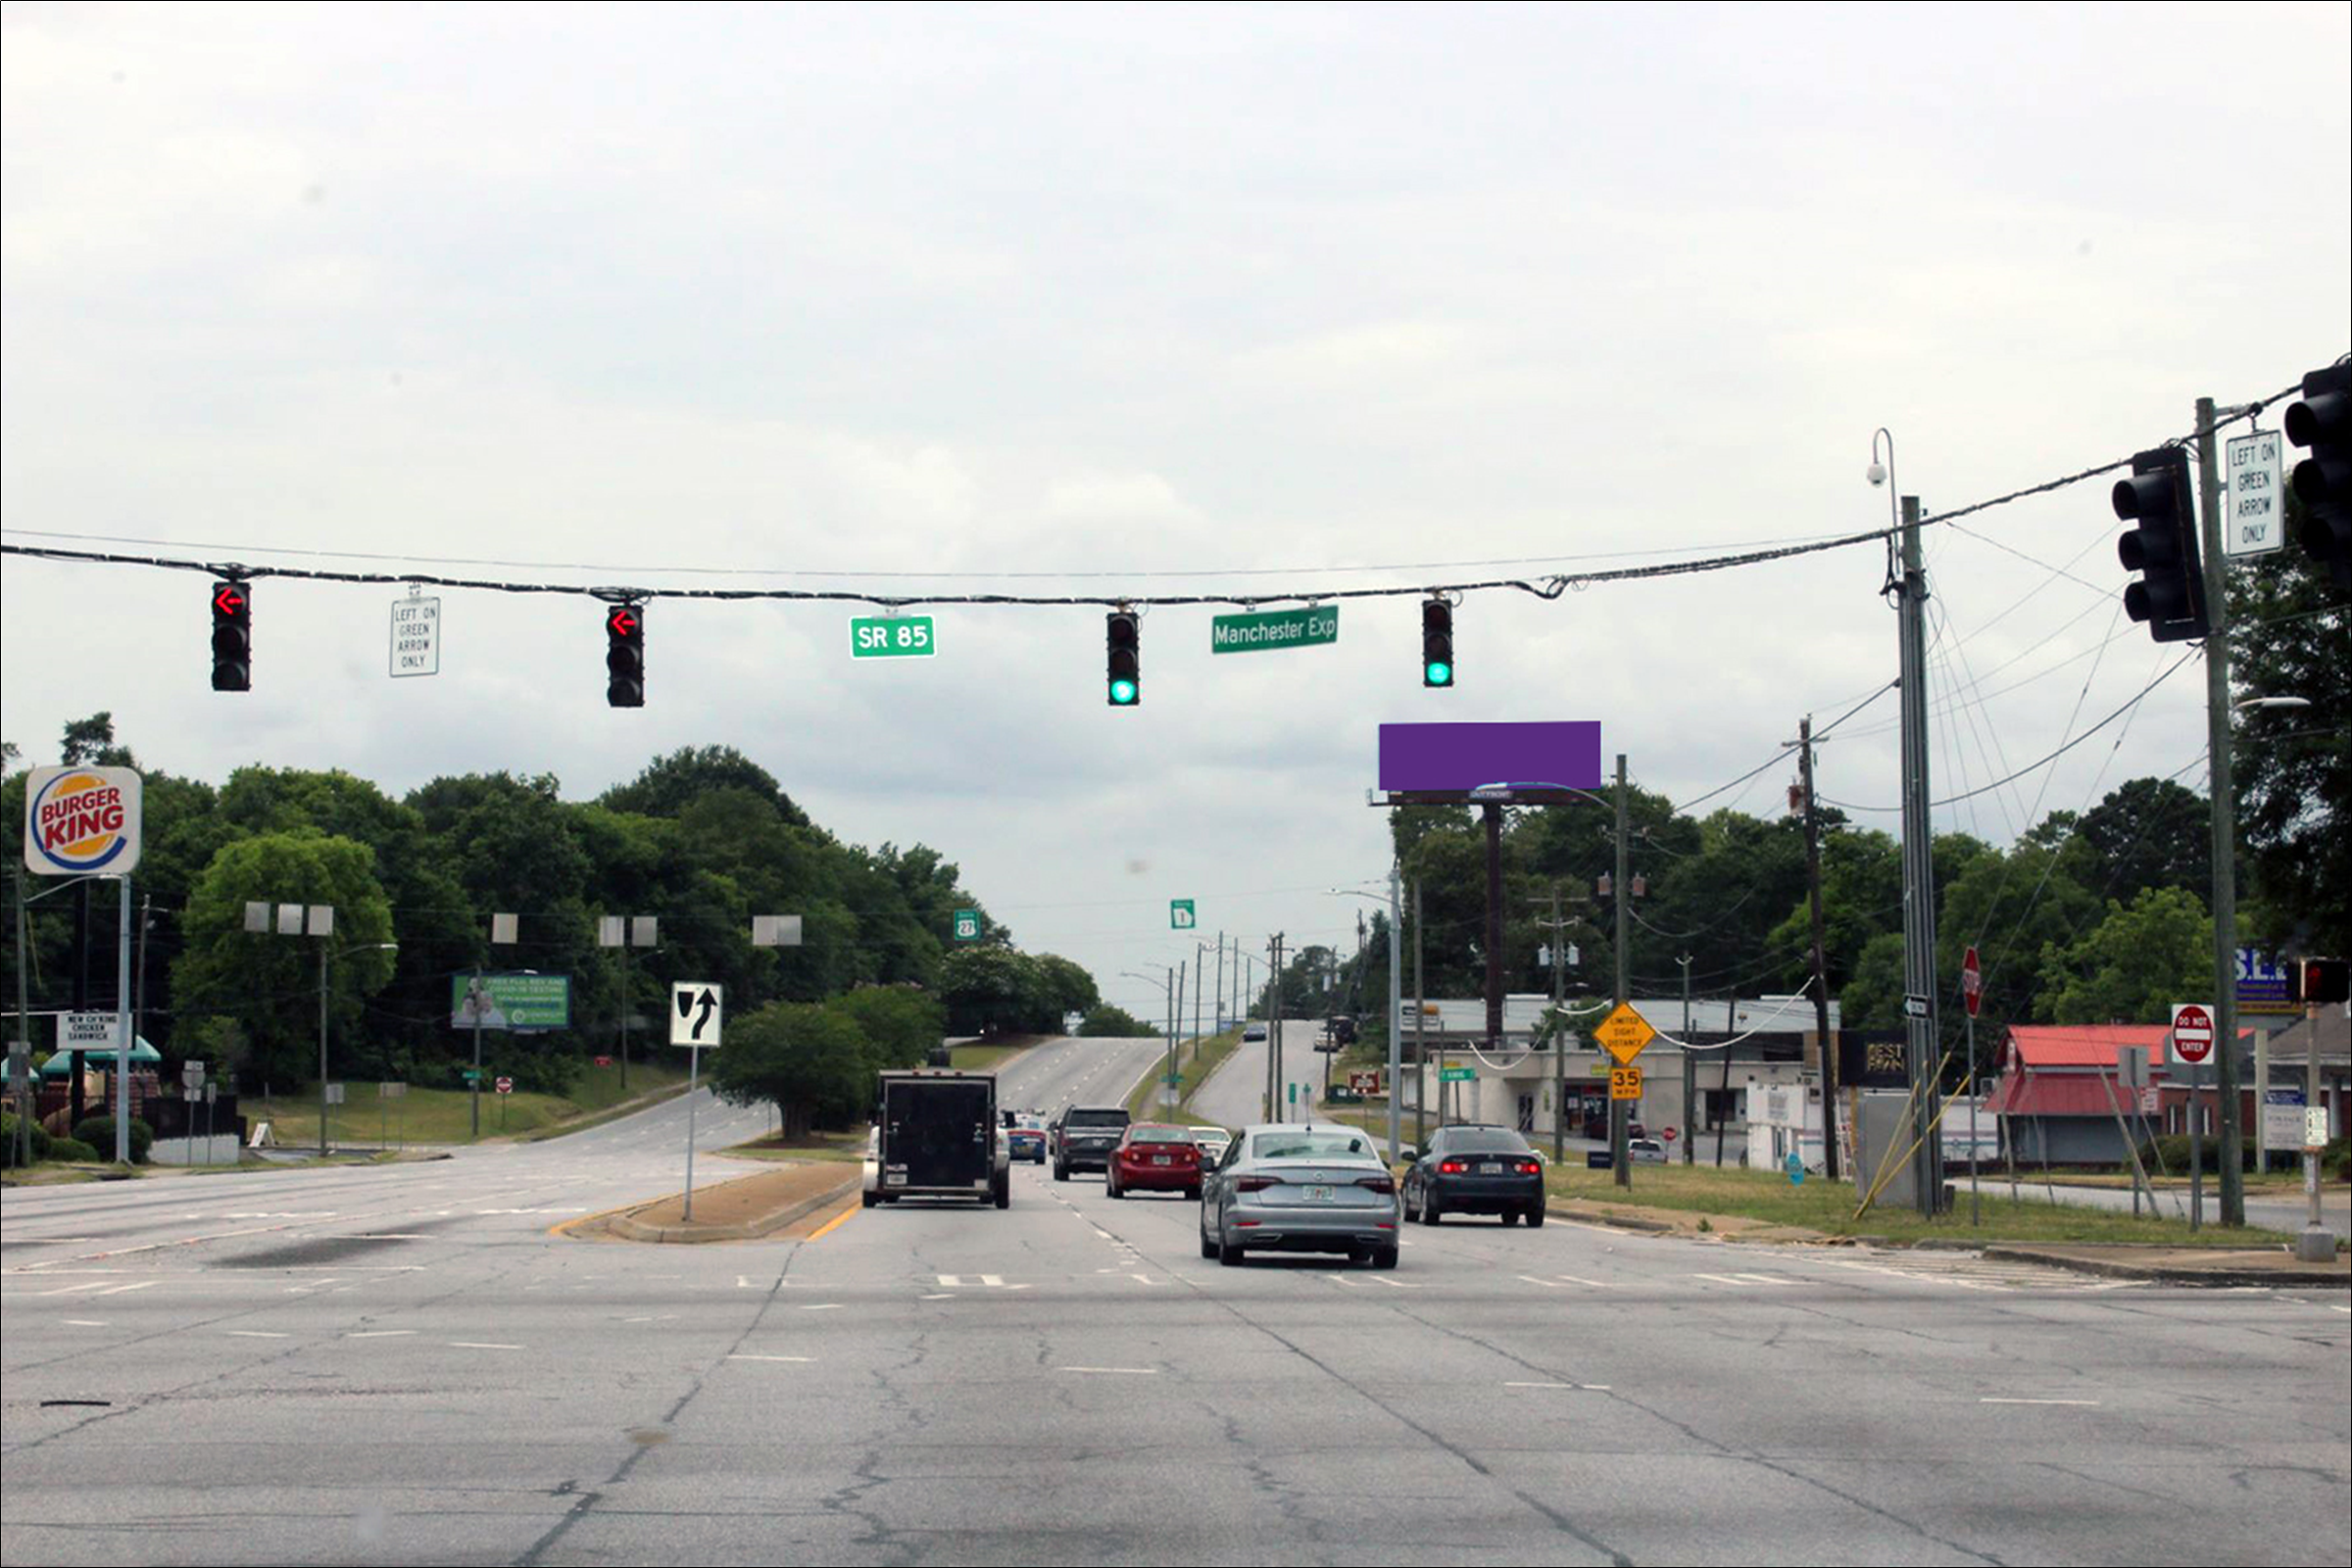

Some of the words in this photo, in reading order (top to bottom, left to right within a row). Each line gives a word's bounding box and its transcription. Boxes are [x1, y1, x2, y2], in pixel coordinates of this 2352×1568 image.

[2232, 446, 2256, 466] LEFT
[2261, 442, 2276, 462] ON
[2238, 470, 2271, 492] GREEN
[2237, 497, 2272, 518] ARROW
[2242, 524, 2267, 544] ONLY
[395, 608, 416, 622] LEFT
[423, 607, 436, 619] ON
[399, 622, 429, 637] GREEN
[858, 626, 888, 649] SR
[898, 625, 928, 648] 85
[1215, 618, 1303, 645] Manchester
[1308, 616, 1336, 639] Exp
[398, 639, 430, 653] ARROW
[401, 655, 425, 668] ONLY
[42, 787, 121, 825] BURGER
[44, 806, 124, 851] KING
[960, 921, 973, 934] 27
[72, 1023, 105, 1032] CHICKEN
[1610, 1016, 1640, 1025] LIMITED
[2178, 1016, 2190, 1026] DO
[2192, 1016, 2207, 1027] NOT
[68, 1032, 108, 1041] SANDWICH
[1614, 1027, 1636, 1037] SIGHT
[2181, 1042, 2204, 1052] ENTER
[1613, 1071, 1639, 1087] 35
